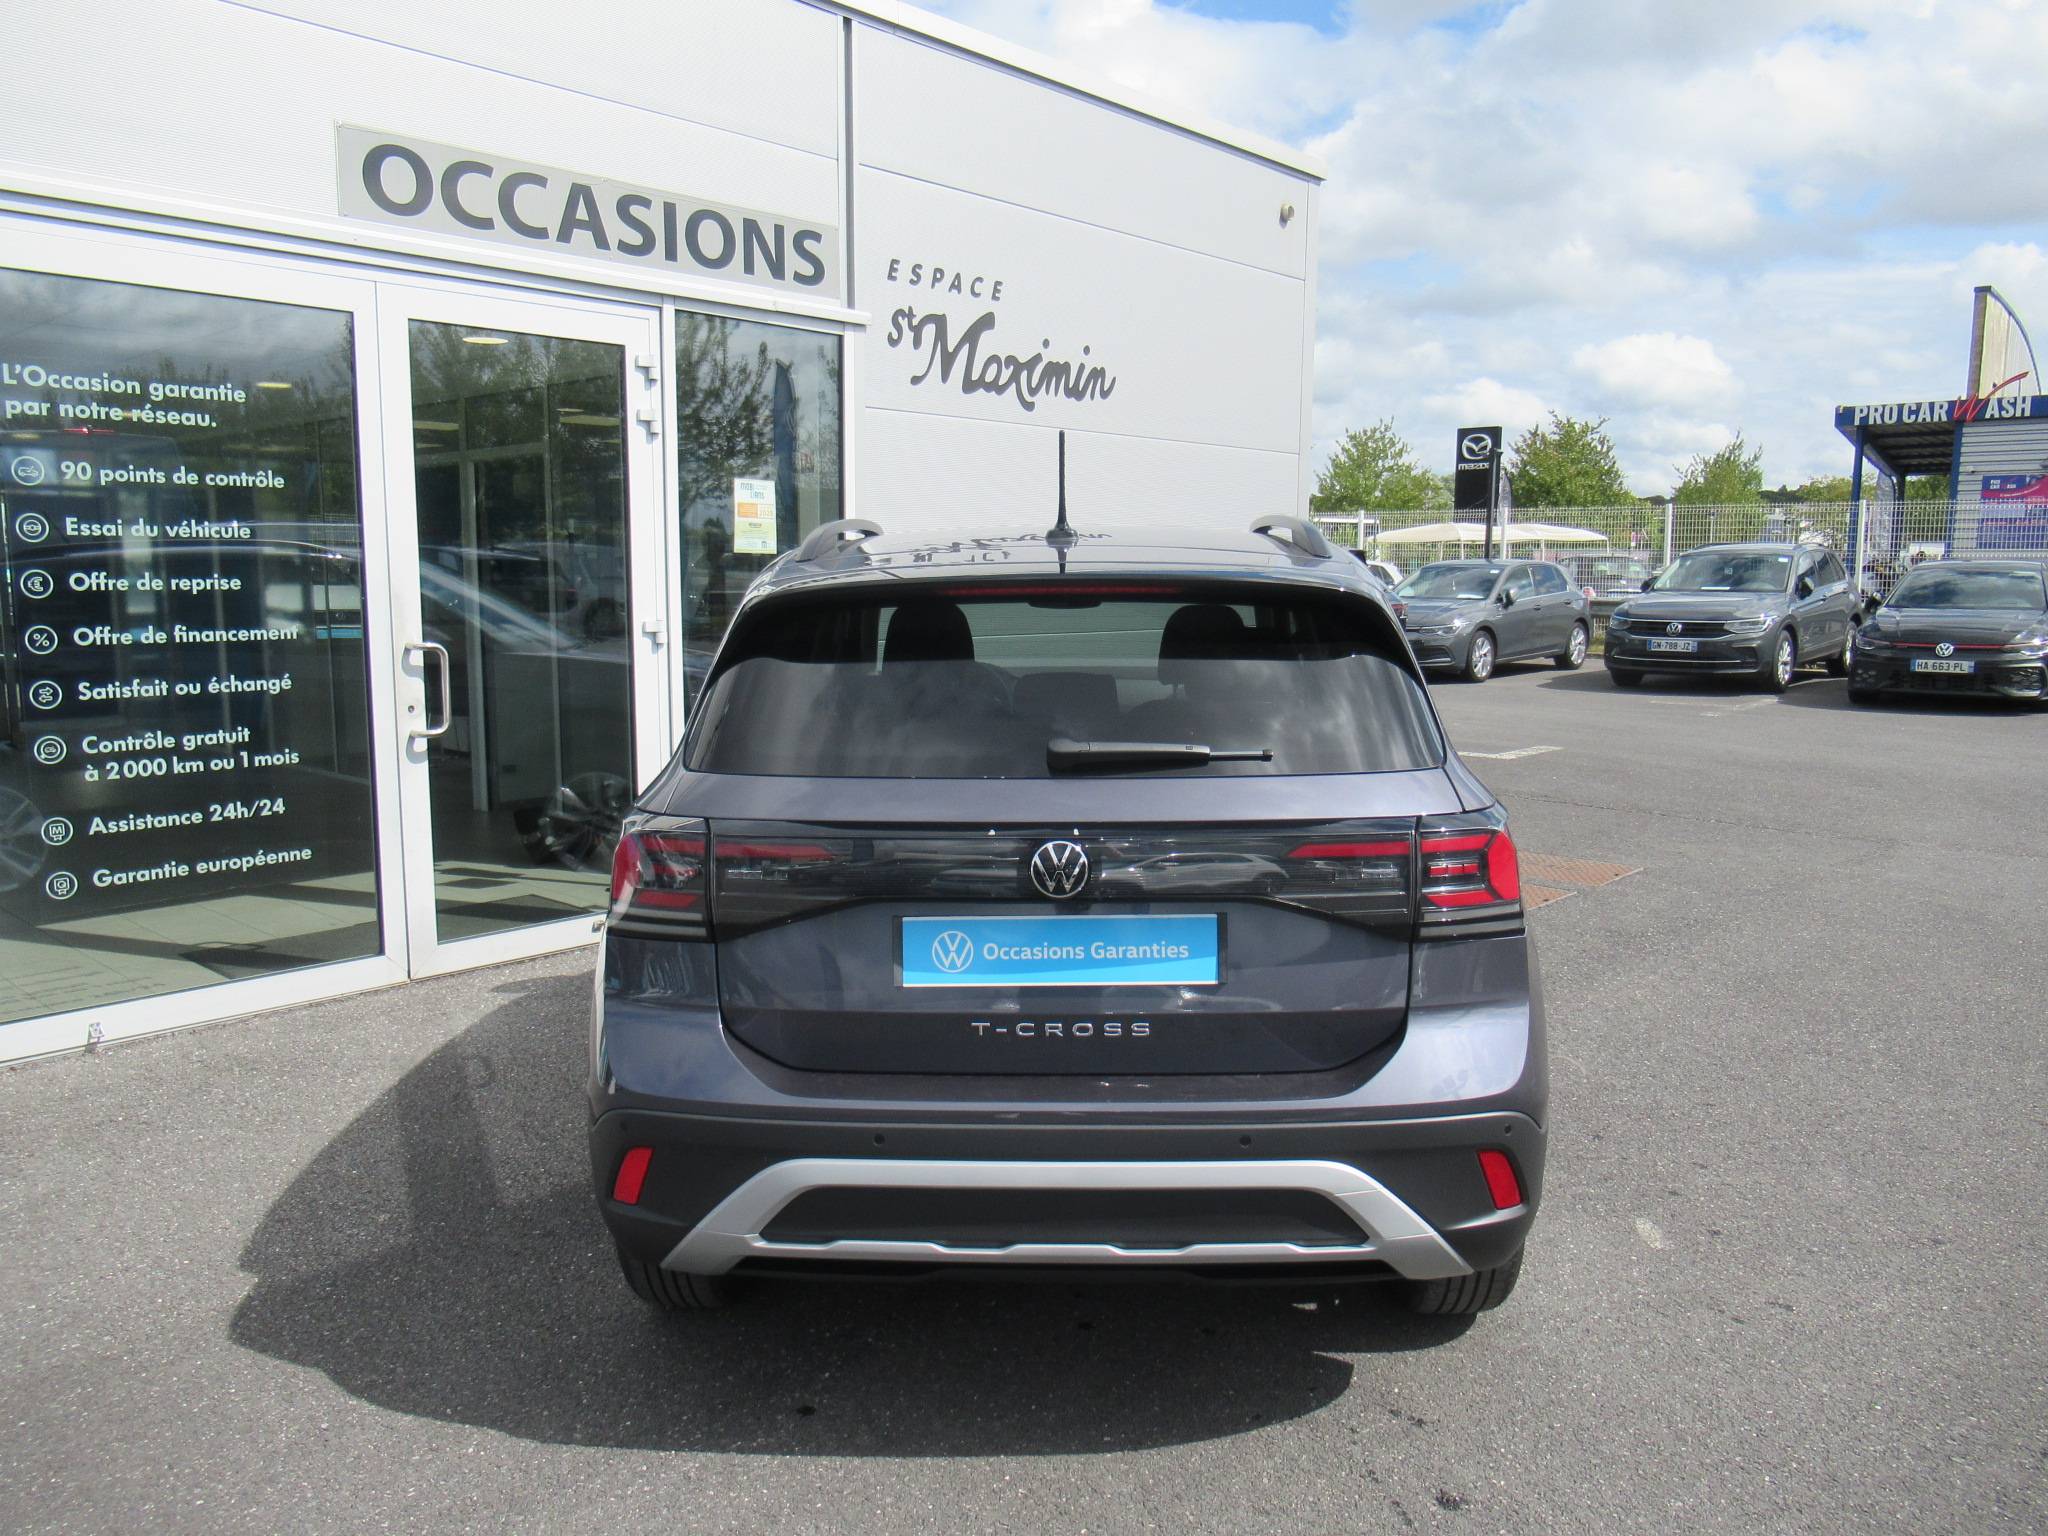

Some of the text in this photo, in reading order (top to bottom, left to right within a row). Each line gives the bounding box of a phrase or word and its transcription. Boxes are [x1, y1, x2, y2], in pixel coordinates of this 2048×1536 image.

[362, 143, 826, 287] OCCASIONS
[887, 259, 1003, 301] ESPACE
[910, 311, 1117, 412] Maximin
[2, 363, 247, 403] L'Occasion garantie
[5, 400, 217, 428] par notre réseau.
[1854, 402, 1898, 426] PRO
[1902, 401, 1949, 424] CAR
[60, 461, 285, 489] 90 points de contrôle
[65, 517, 251, 539] Essai du véhicule
[69, 572, 242, 595] Offre de reprise
[73, 625, 298, 646] Offre de financement
[77, 673, 293, 701] Satisfait ou échangé
[82, 726, 251, 754] Contrôle gratuit
[84, 764, 99, 782] à
[173, 756, 205, 775] km
[210, 757, 235, 771] ou
[240, 751, 249, 768] 1
[254, 748, 300, 767] mois
[88, 797, 286, 836] Assistance 24h/24
[93, 847, 312, 888] Garantie européenne
[983, 942, 1085, 961] Occasions
[1090, 940, 1189, 959] Garanties
[971, 1022, 1151, 1036] T-CROSS
